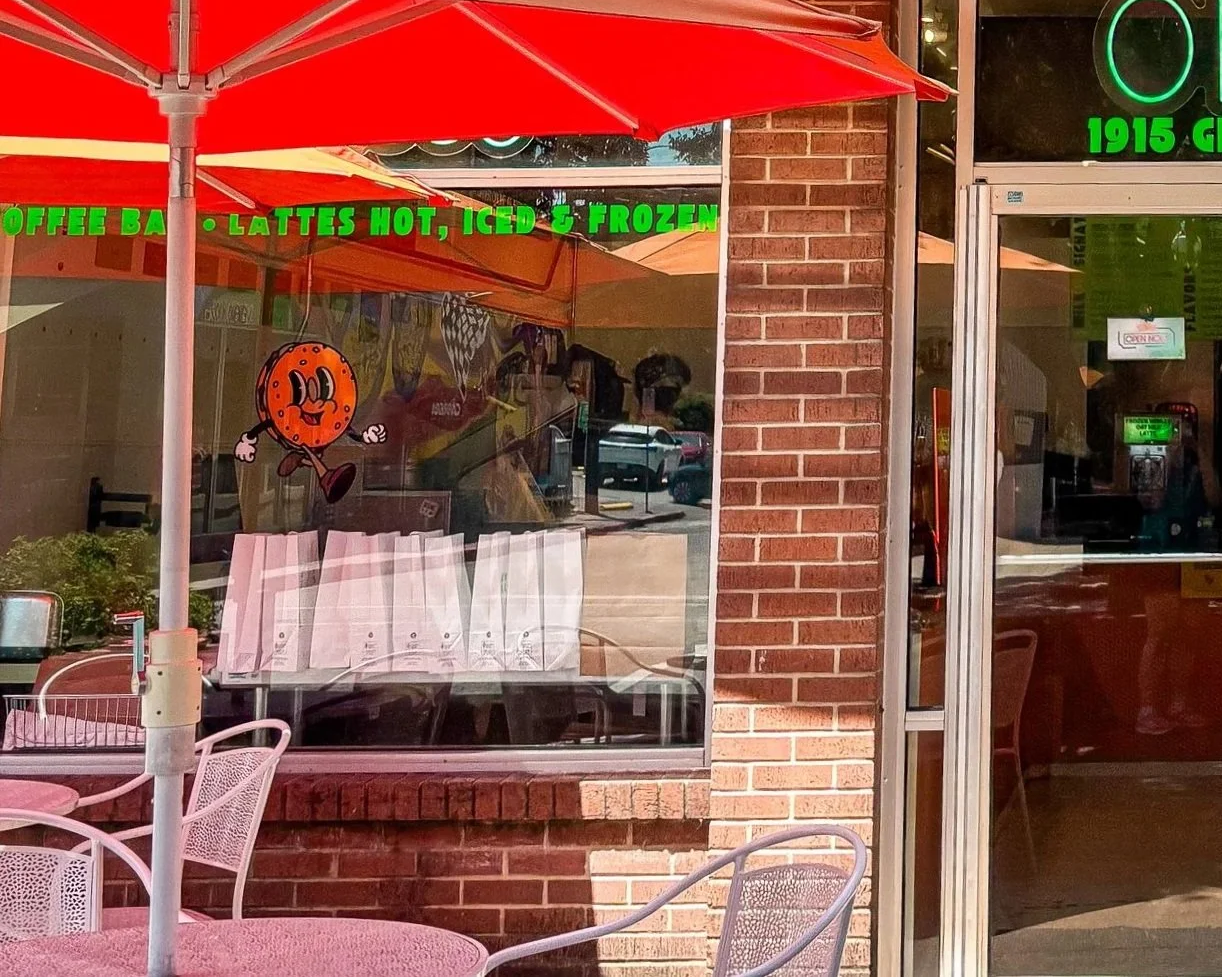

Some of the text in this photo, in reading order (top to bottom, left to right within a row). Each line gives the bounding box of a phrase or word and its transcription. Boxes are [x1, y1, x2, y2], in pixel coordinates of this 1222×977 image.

[1087, 116, 1175, 154] 1915
[228, 207, 356, 237] LATTES
[369, 205, 449, 241] HOT,
[462, 205, 537, 236] ICED
[550, 203, 575, 234] &
[588, 203, 720, 233] FROZEN
